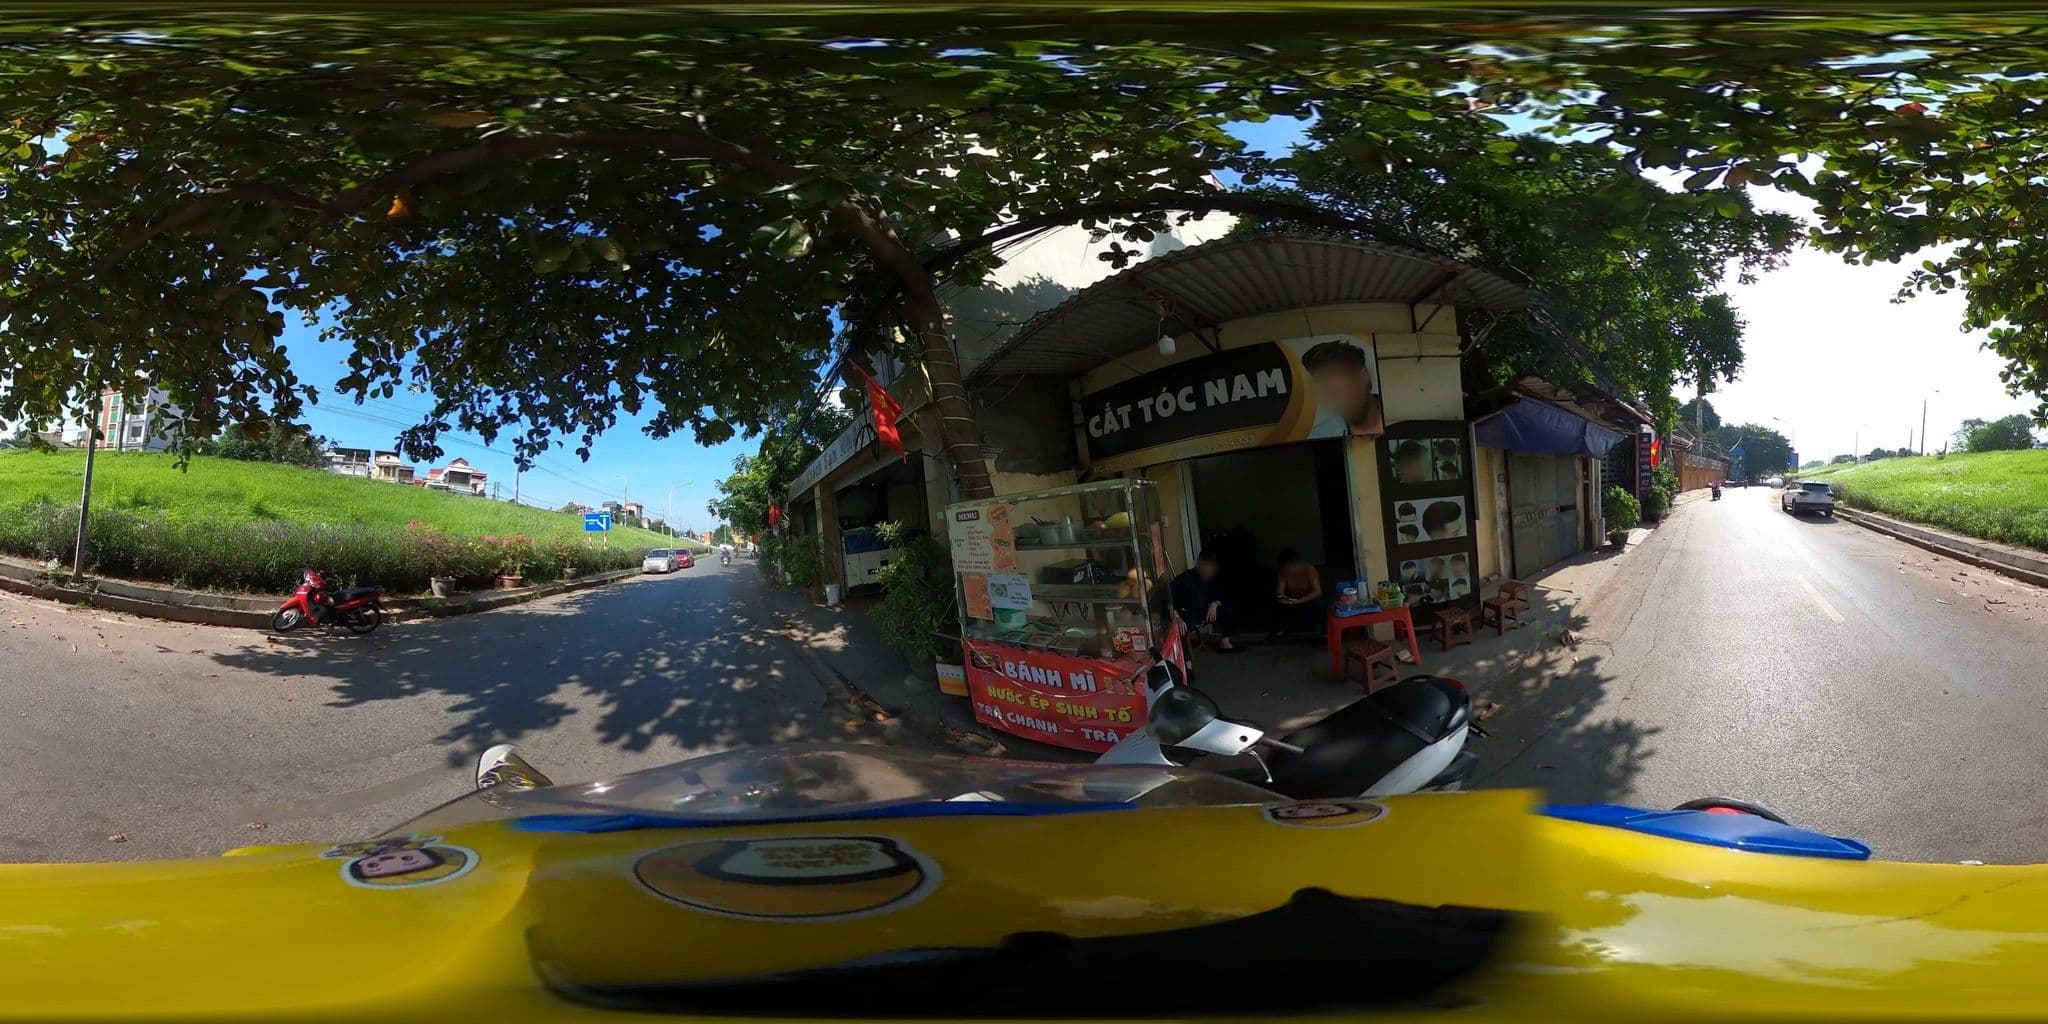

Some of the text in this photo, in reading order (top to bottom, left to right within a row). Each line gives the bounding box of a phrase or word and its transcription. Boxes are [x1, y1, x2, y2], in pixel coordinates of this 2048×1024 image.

[1089, 368, 1287, 438] CẮT TÓC NAM
[958, 511, 977, 521] MENU
[1004, 660, 1097, 692] BÁNH MÌ
[987, 686, 1133, 722] NƯỚC ÉP SINH TỐ
[977, 702, 1003, 720] TRÀ
[1007, 711, 1058, 733] CHANH
[1081, 727, 1120, 743] TRÀ
